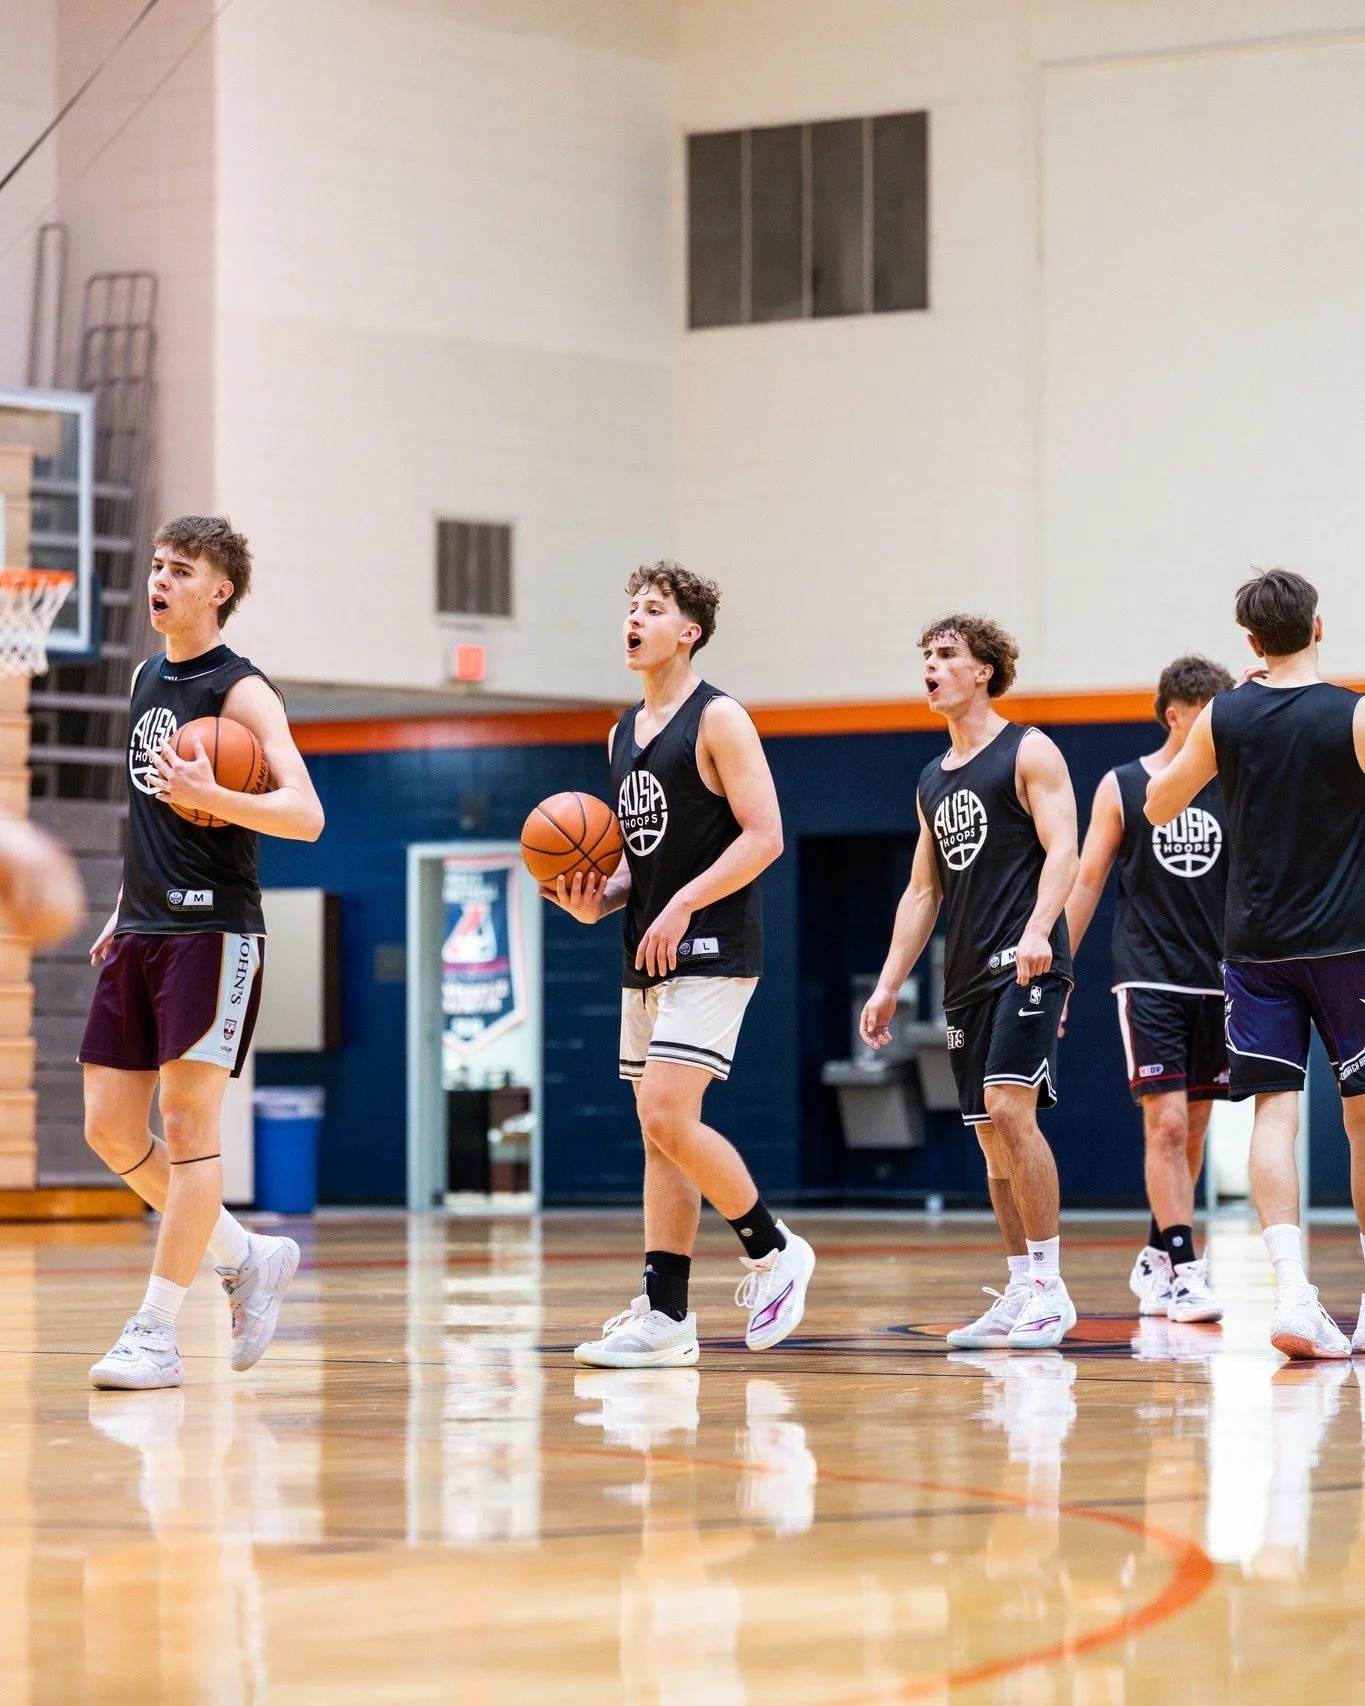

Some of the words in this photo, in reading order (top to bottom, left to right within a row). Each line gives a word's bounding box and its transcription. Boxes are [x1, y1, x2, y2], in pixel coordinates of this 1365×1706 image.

[618, 770, 668, 818] AUSA
[934, 789, 988, 839] AUSA
[624, 814, 658, 829] HOOPS
[943, 828, 975, 848] HOOPS
[1164, 843, 1210, 853] HOOPS
[193, 893, 204, 903] M
[702, 942, 711, 951] L
[1008, 950, 1017, 960] M
